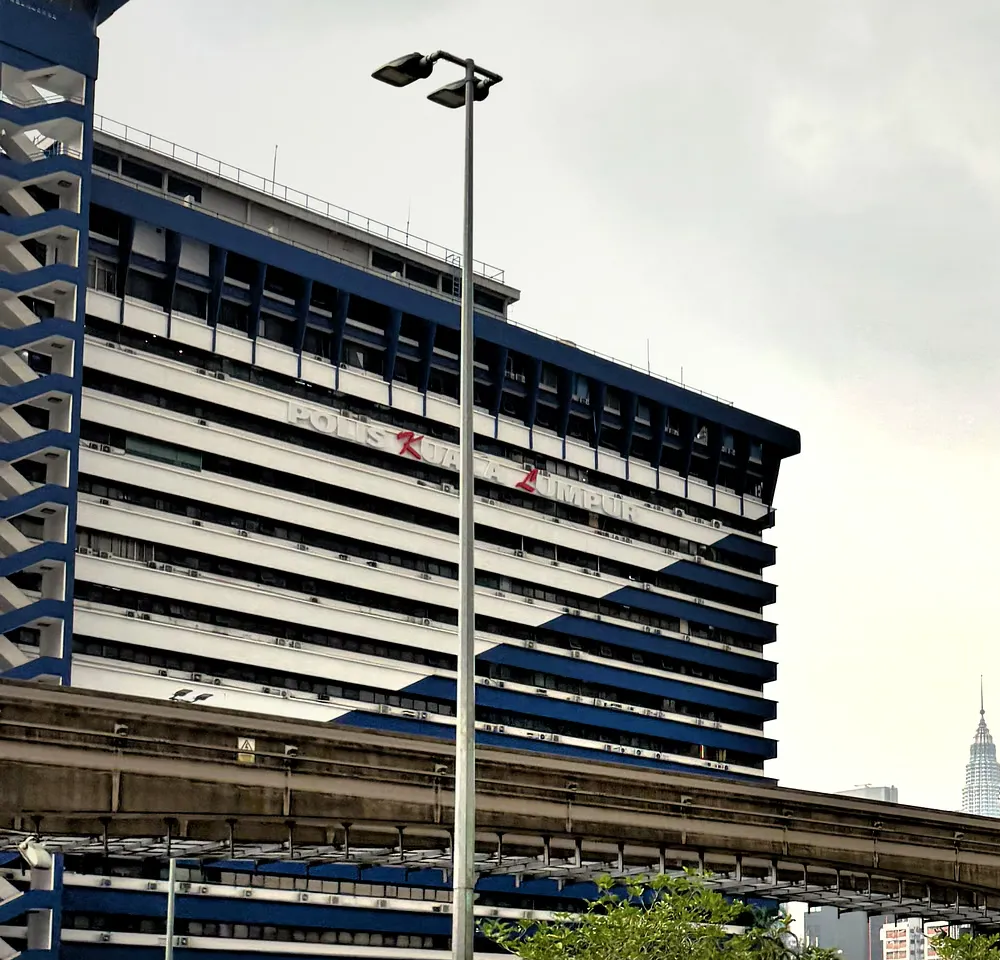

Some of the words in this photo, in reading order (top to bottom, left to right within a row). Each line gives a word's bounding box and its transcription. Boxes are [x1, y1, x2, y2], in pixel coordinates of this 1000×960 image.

[288, 401, 386, 446] POLIS
[396, 431, 498, 481] KUAA
[515, 468, 638, 521] LUMPUR
